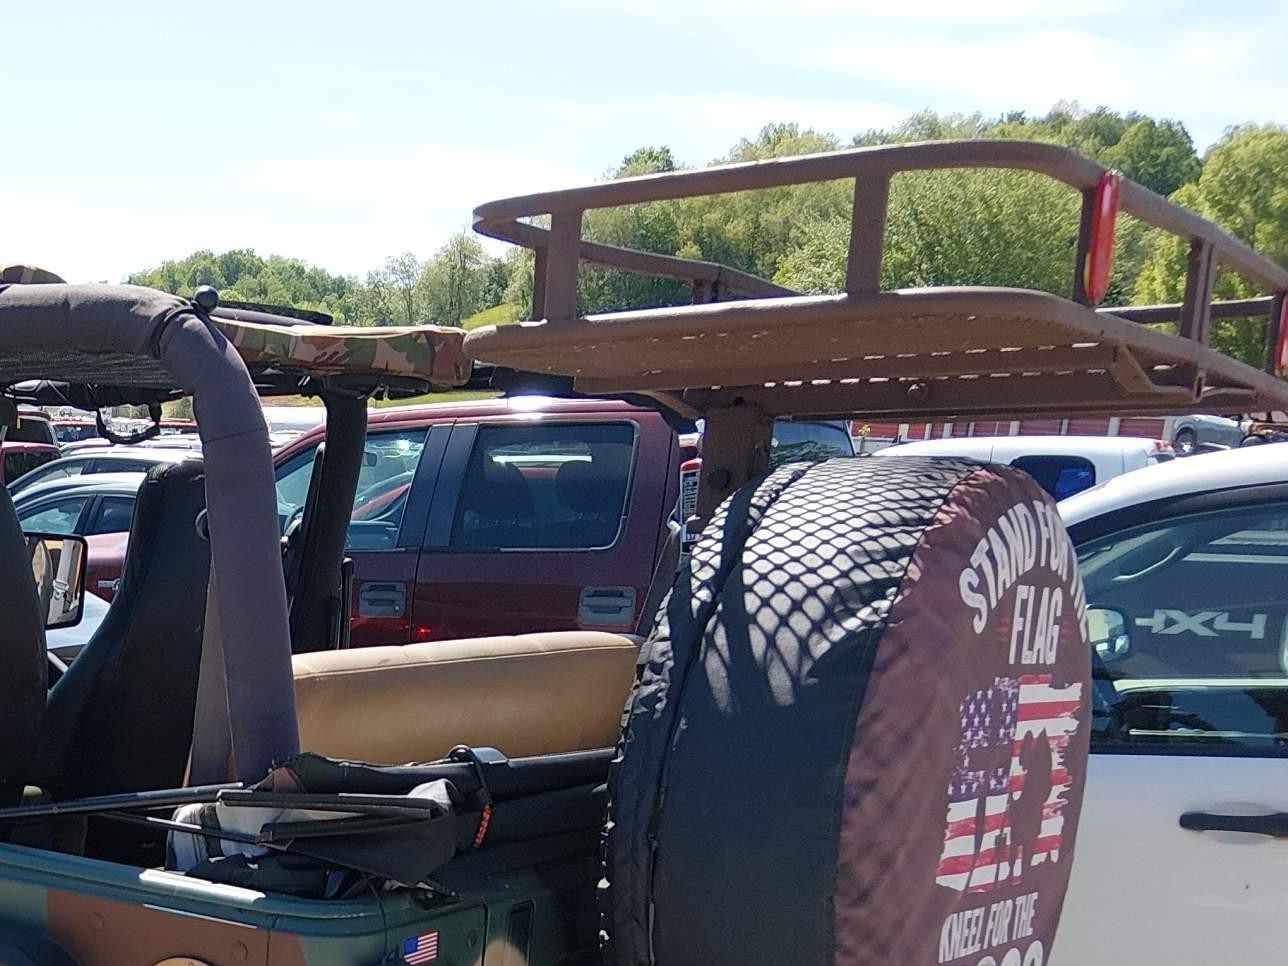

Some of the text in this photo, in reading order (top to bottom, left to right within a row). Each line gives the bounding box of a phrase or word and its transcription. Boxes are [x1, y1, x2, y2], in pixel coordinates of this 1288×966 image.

[959, 502, 1036, 634] STAND
[1009, 585, 1062, 666] FLAG
[1135, 608, 1268, 640] 4X4
[938, 892, 1038, 964] KNEEL FOR THE
